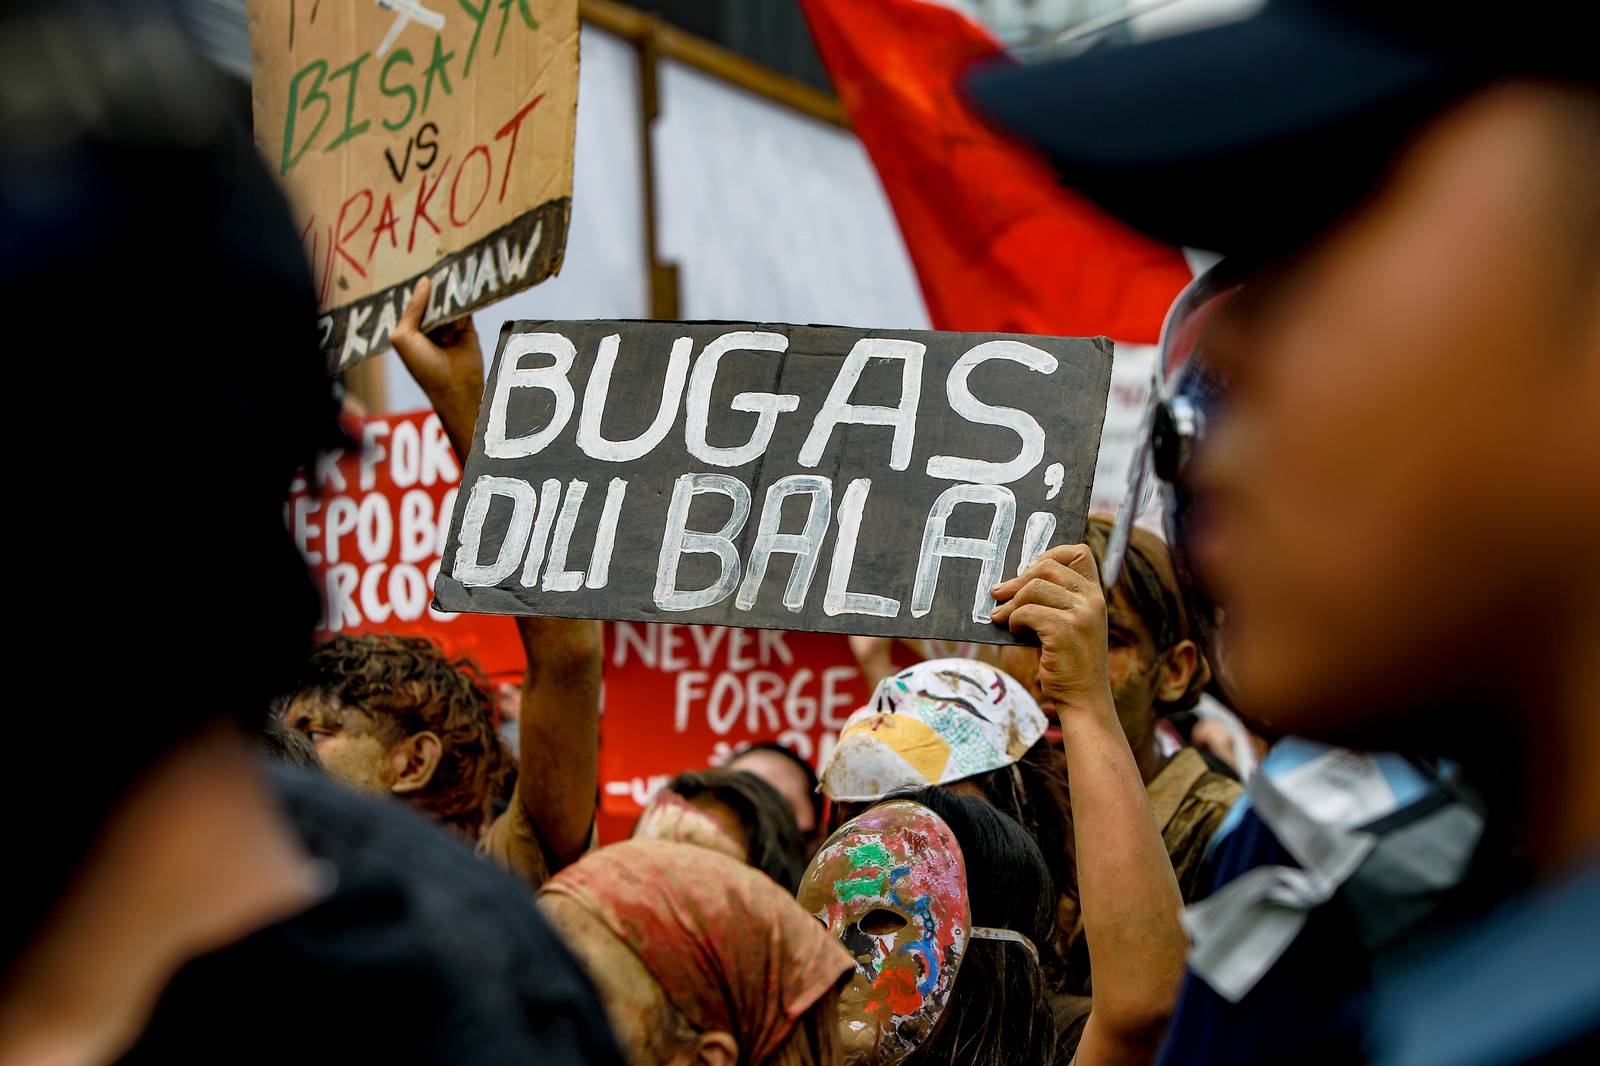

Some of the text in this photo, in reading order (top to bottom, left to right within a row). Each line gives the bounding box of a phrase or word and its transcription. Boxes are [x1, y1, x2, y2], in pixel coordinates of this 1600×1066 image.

[384, 122, 439, 183] VS
[359, 414, 461, 490] FOR
[483, 331, 1065, 501] BUGAS,
[284, 490, 393, 565] EPO
[453, 473, 628, 592] DILI
